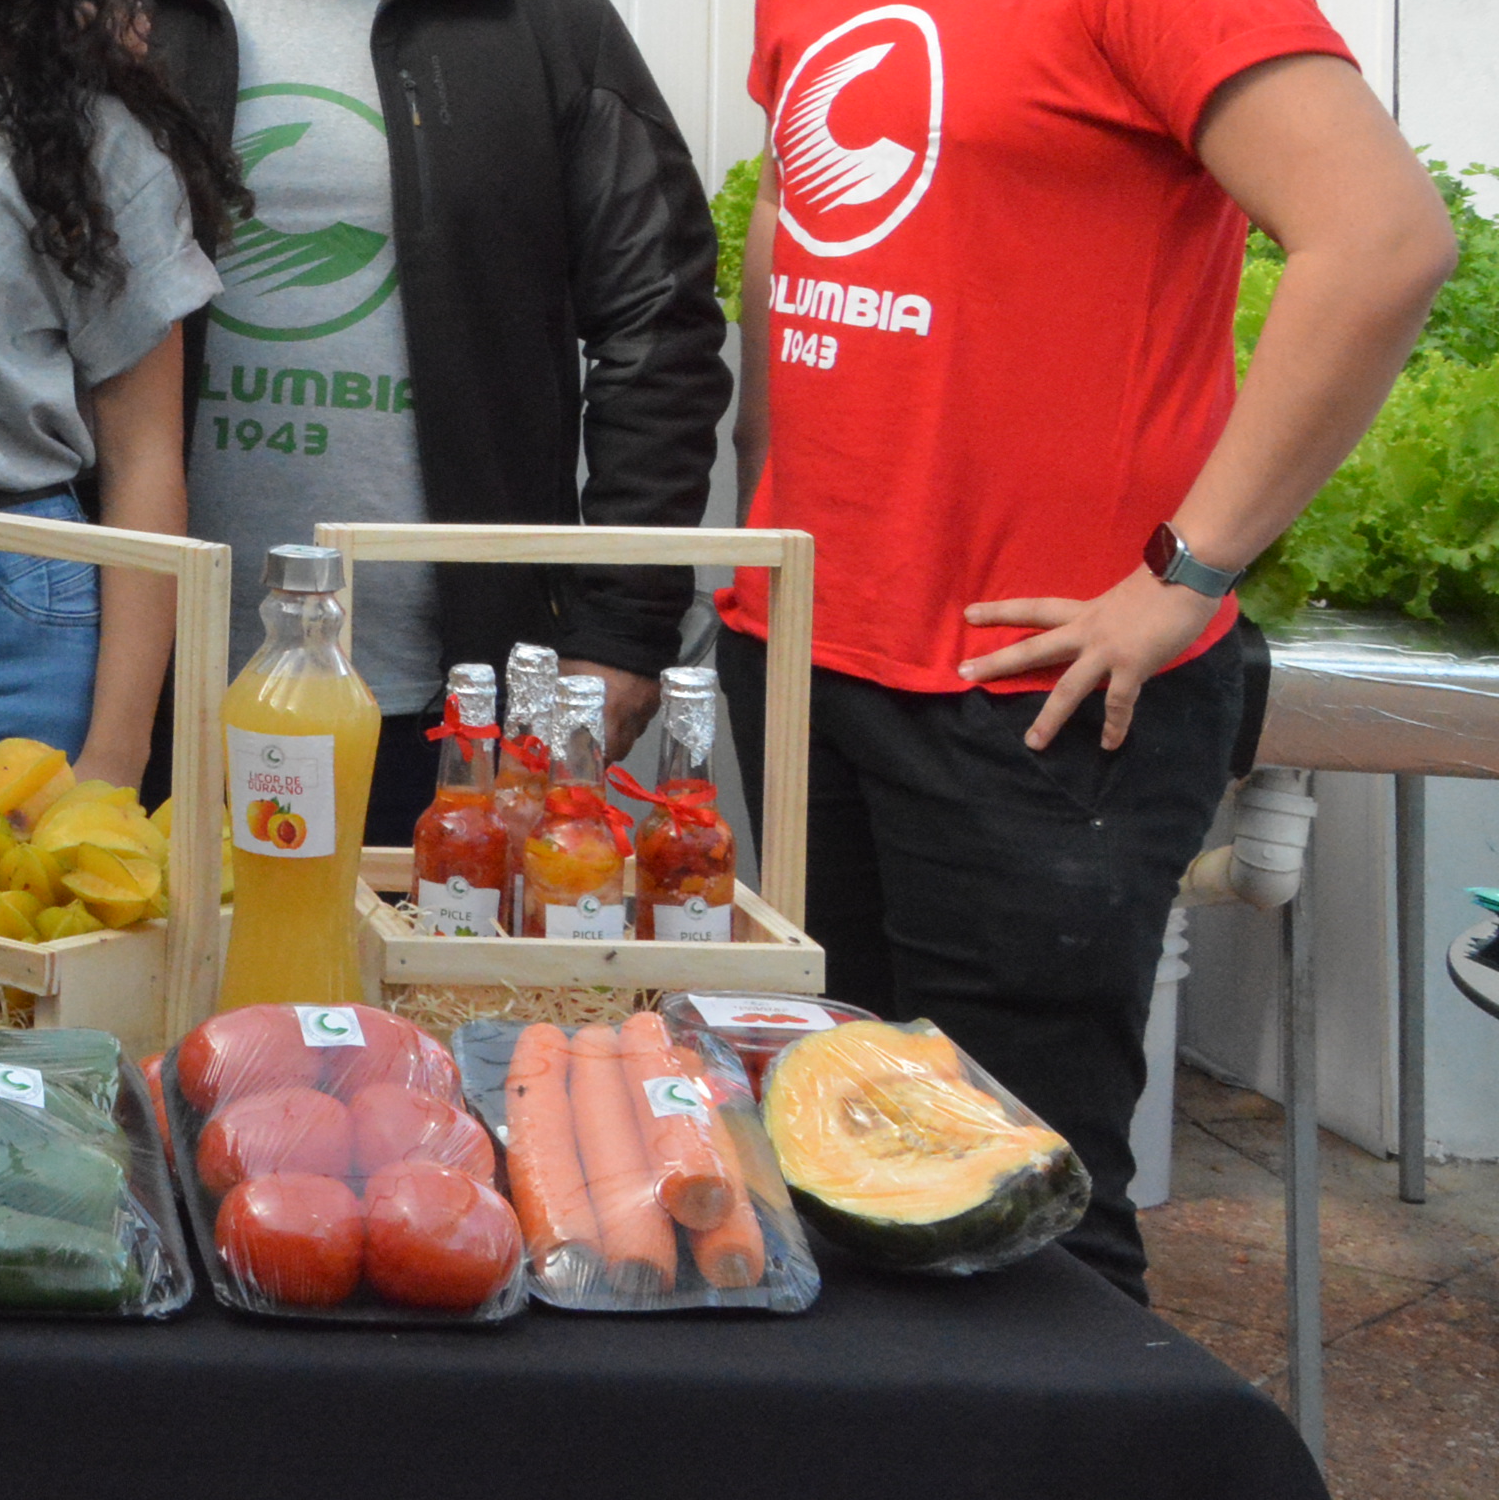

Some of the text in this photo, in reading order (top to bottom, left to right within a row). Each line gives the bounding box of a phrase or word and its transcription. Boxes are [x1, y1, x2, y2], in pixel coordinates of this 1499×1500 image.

[780, 327, 839, 370] 1943
[213, 416, 329, 456] 1943
[249, 770, 301, 787] LICOR DE
[248, 780, 304, 796] DURAZNO
[440, 908, 472, 922] PICLE
[572, 930, 604, 941] PICLE
[680, 931, 712, 942] PICLE
